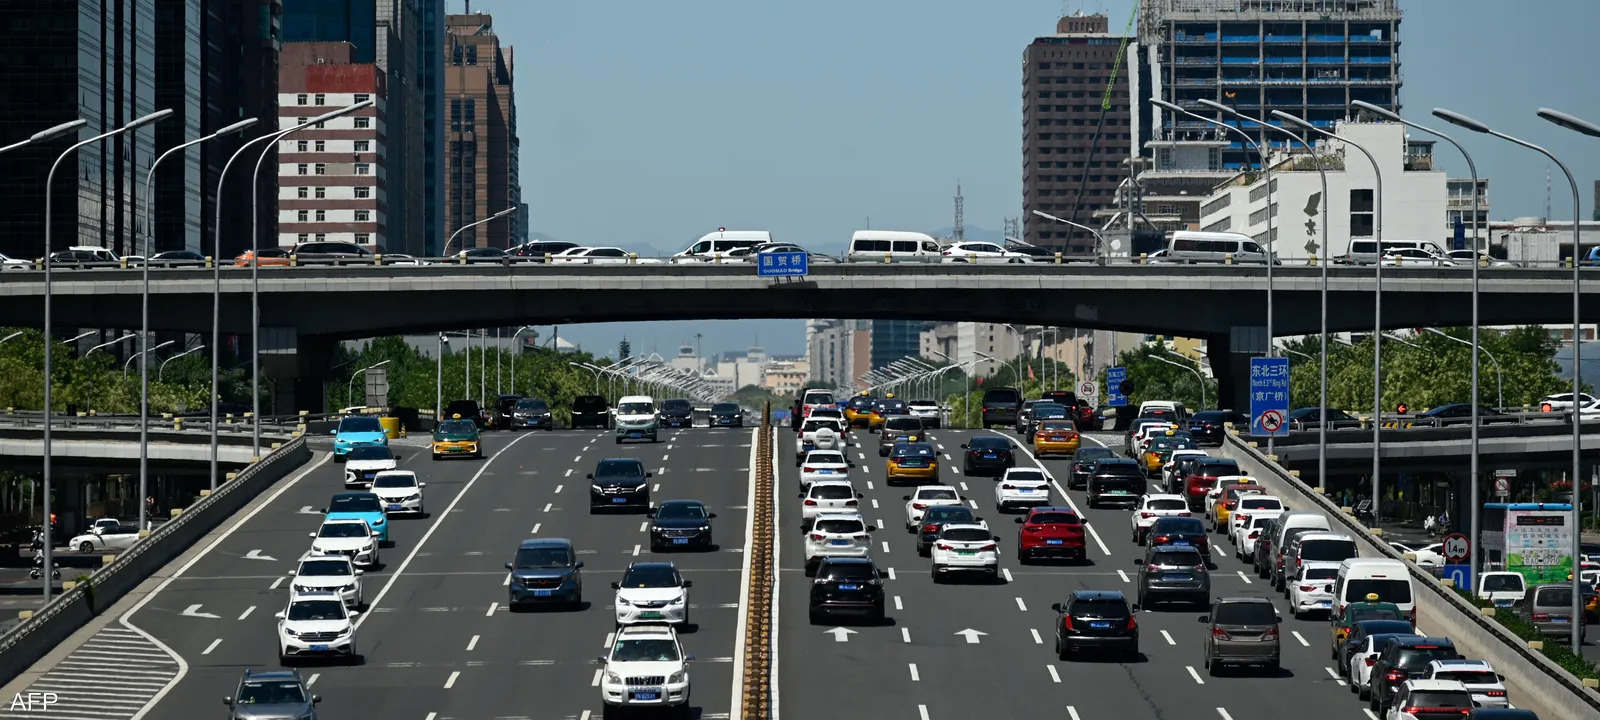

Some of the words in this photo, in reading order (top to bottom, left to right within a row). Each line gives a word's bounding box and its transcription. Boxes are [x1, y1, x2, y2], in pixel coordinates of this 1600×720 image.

[763, 255, 801, 266] 国贸桥
[1252, 365, 1287, 376] 东北三环
